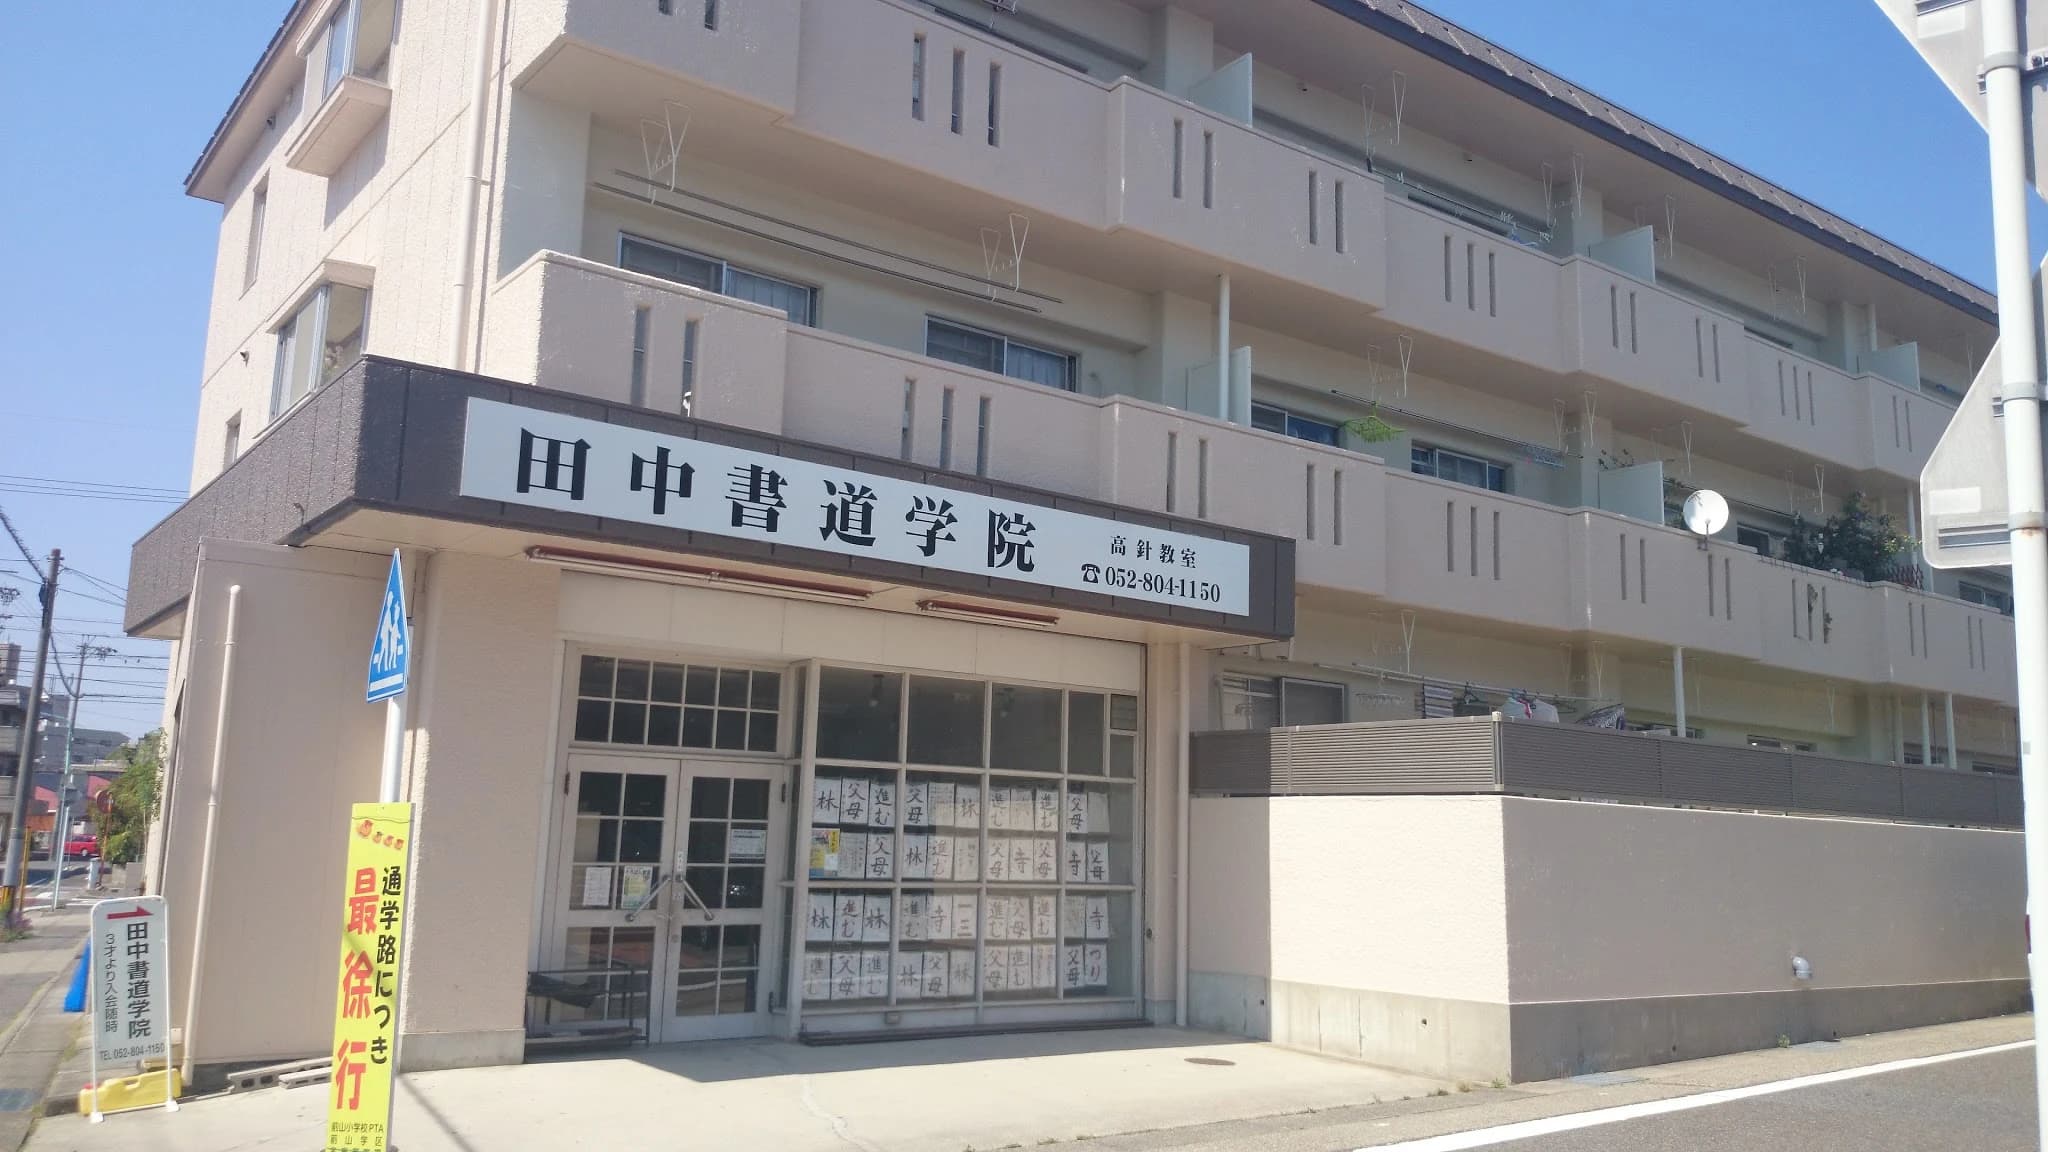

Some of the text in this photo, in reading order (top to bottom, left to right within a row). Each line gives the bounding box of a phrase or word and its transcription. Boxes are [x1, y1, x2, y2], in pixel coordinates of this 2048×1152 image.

[516, 427, 1036, 572] 田中書道学院
[1110, 536, 1197, 569] 高針教室
[1105, 566, 1221, 603] 052-804-1150
[816, 788, 840, 812] 林
[846, 782, 866, 819] 父母
[874, 788, 892, 825] 進む
[906, 787, 923, 824] 父母
[871, 836, 891, 876] 父母
[906, 846, 922, 865] 林
[811, 906, 830, 929] 林
[842, 899, 858, 937] 進む
[864, 907, 888, 929] 林
[1090, 905, 1104, 930] 寺
[127, 922, 151, 1039] 田中書道学院
[371, 866, 402, 1065] 通学路につき
[335, 867, 380, 1111] 最徐行
